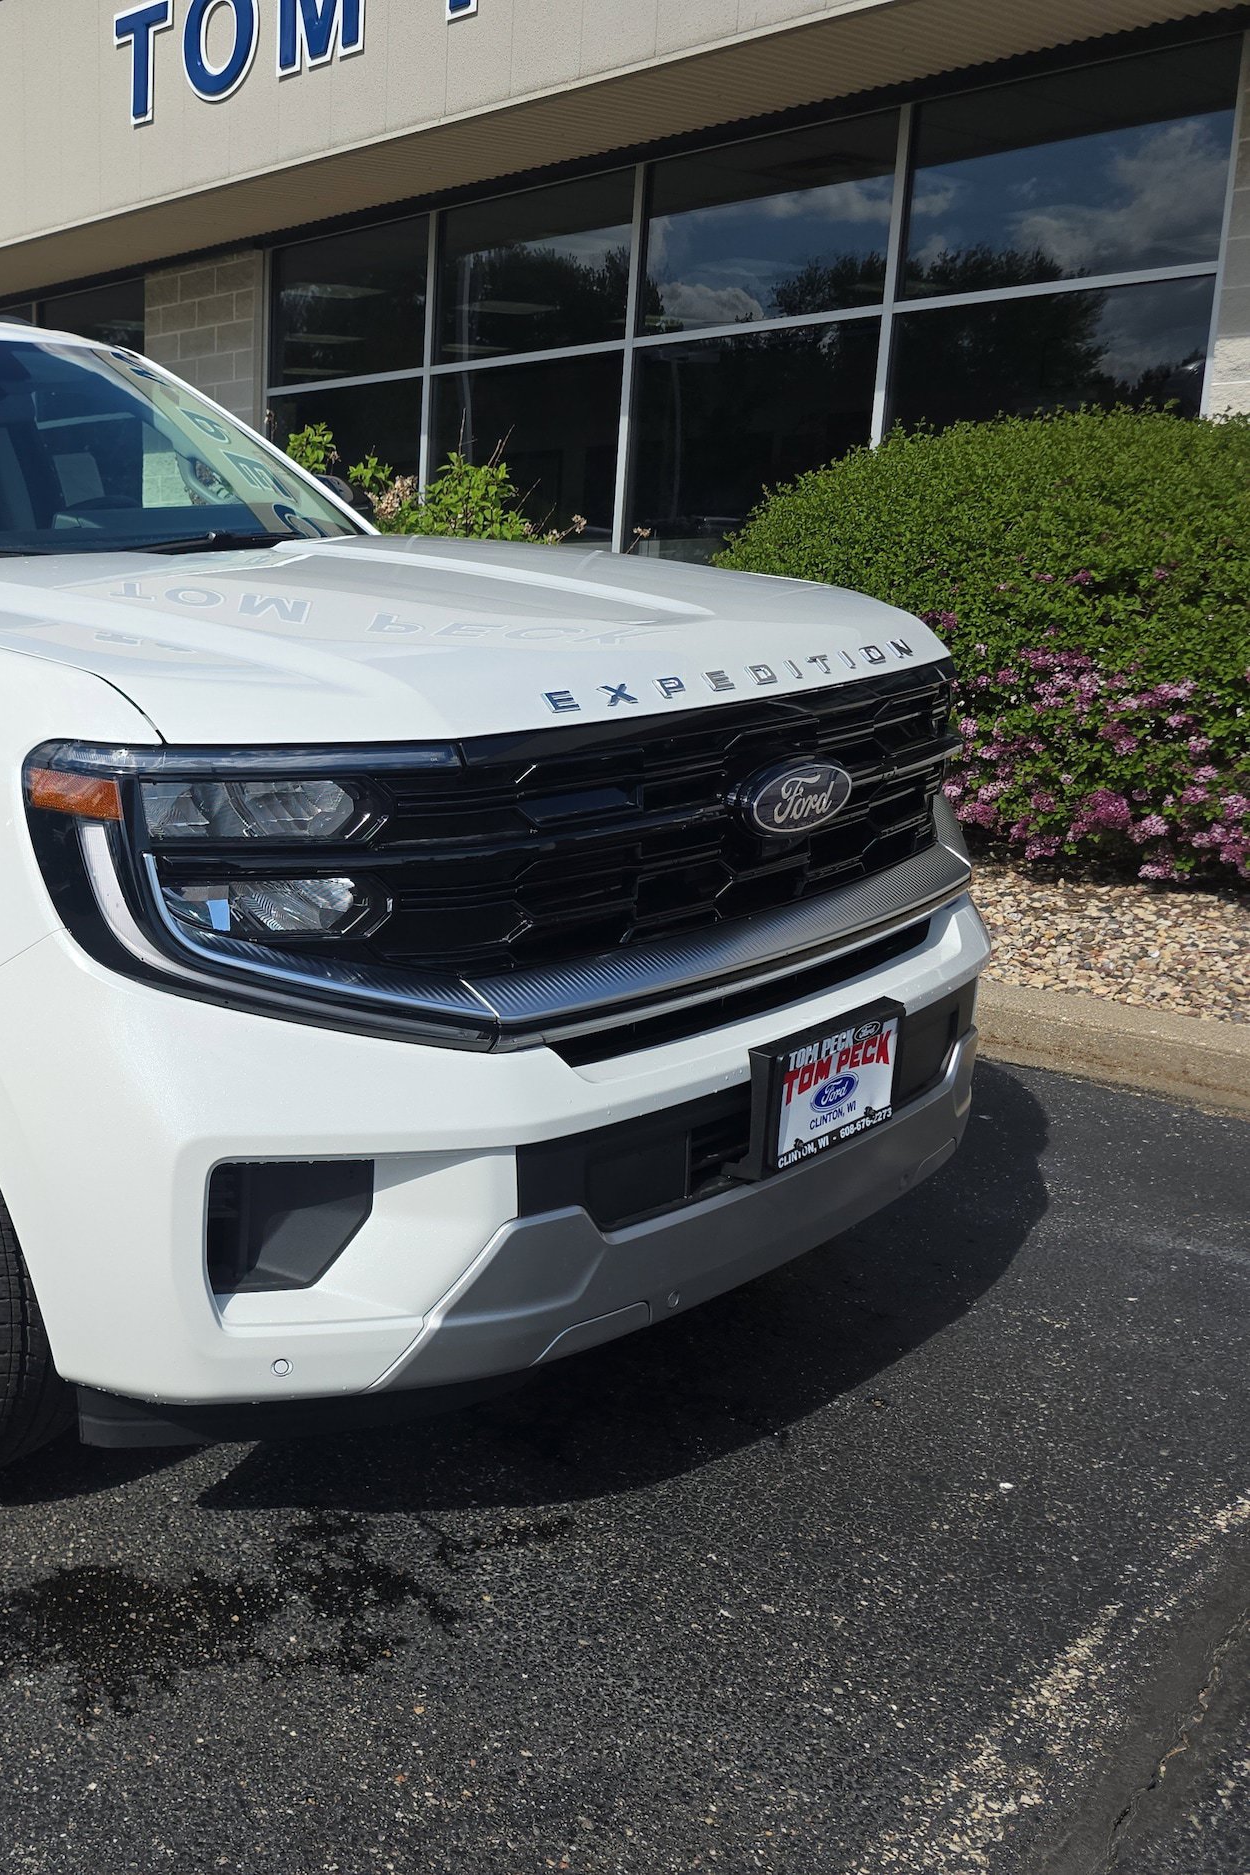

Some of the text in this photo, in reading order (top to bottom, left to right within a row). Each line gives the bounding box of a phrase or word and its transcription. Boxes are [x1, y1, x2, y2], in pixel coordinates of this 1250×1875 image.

[114, 0, 364, 125] TOM
[540, 638, 914, 714] EXPEDITION
[773, 773, 835, 824] Ford
[783, 1030, 892, 1106] TOM PECK
[788, 1042, 820, 1070] TOM
[821, 1028, 856, 1059] PECK
[820, 1078, 849, 1105] Ford
[809, 1101, 857, 1130] CLINTON, WI
[818, 1135, 830, 1149] WI
